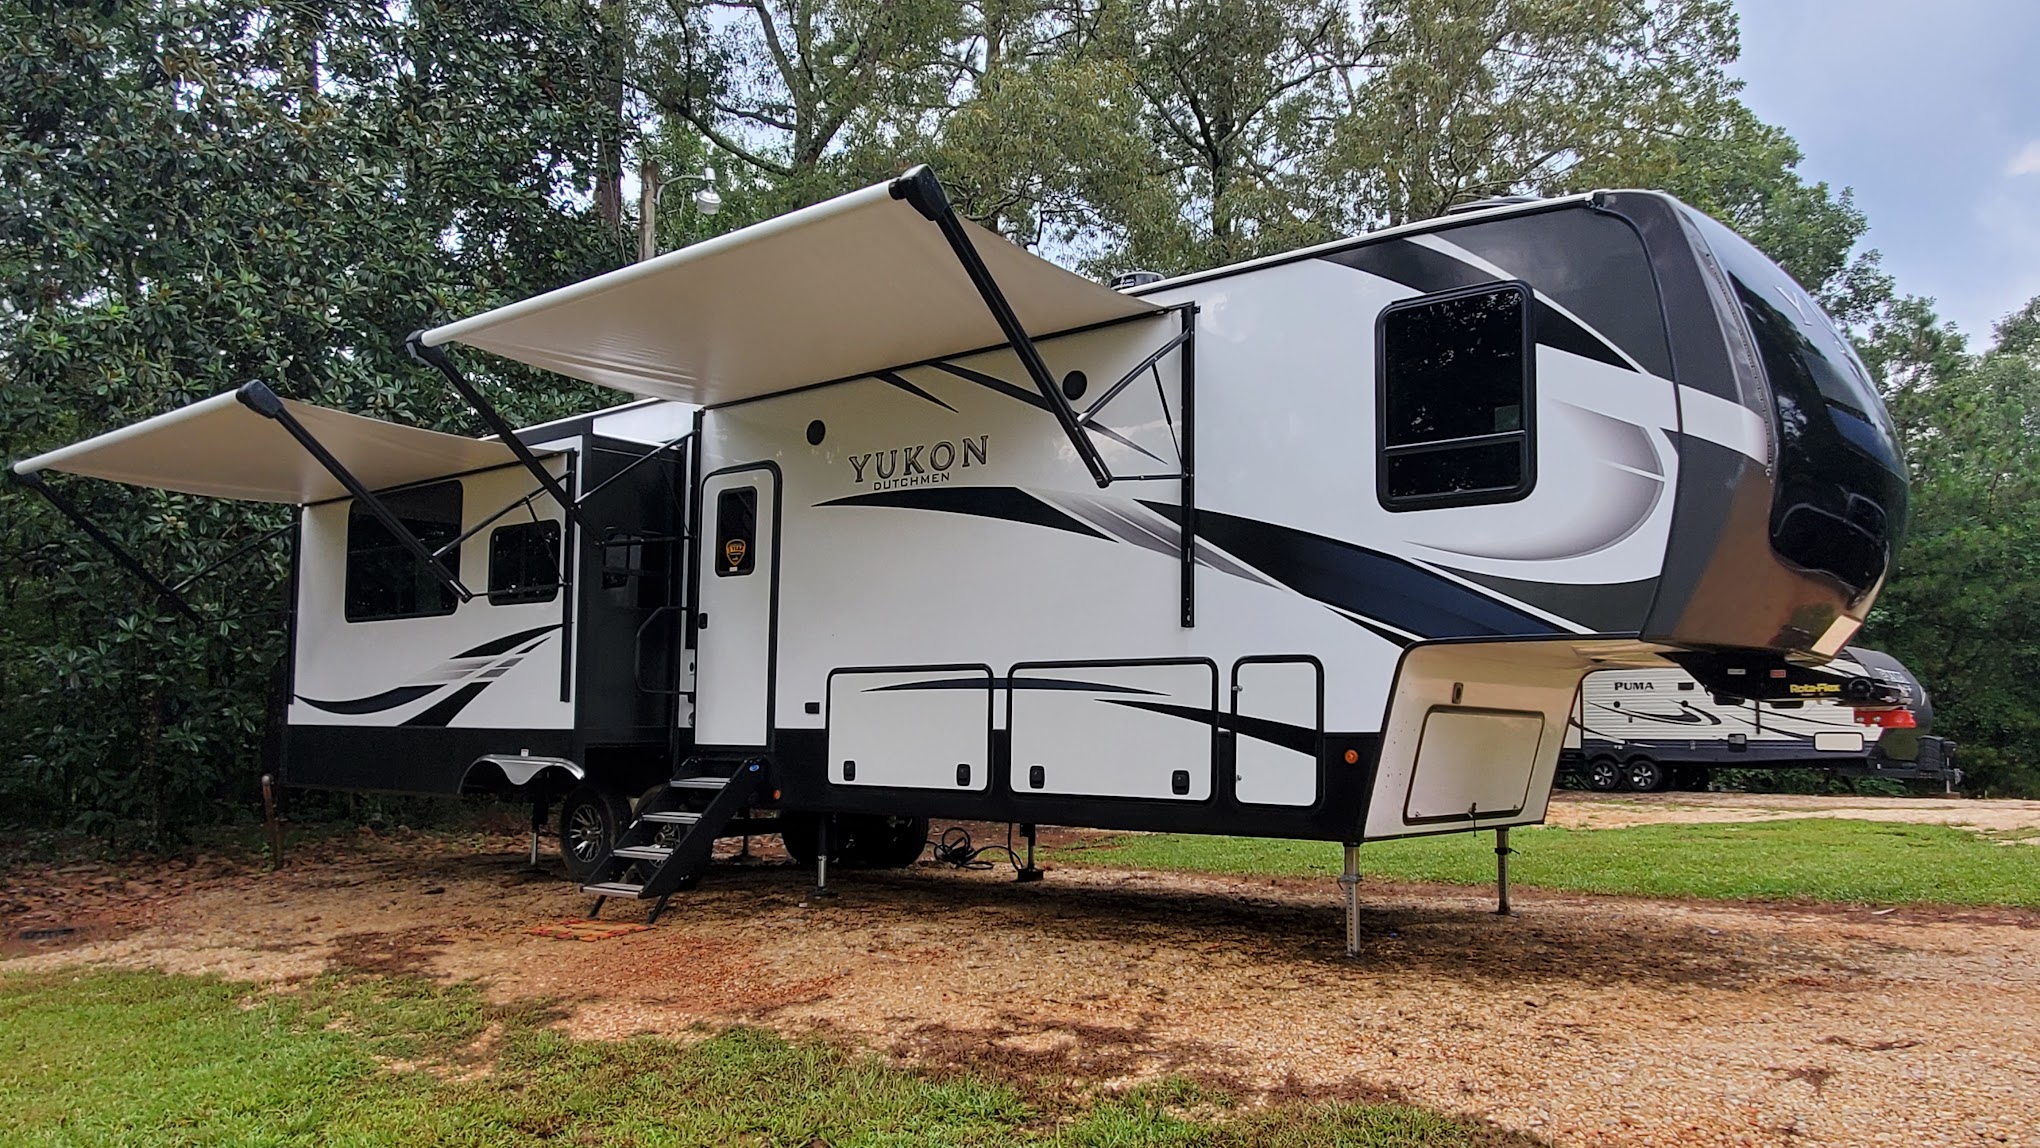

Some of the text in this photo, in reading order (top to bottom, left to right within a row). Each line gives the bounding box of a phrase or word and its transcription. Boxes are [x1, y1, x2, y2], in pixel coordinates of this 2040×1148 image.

[849, 435, 989, 483] YUKON
[873, 472, 950, 491] DUTCHMEN
[1614, 681, 1654, 691] PUMA
